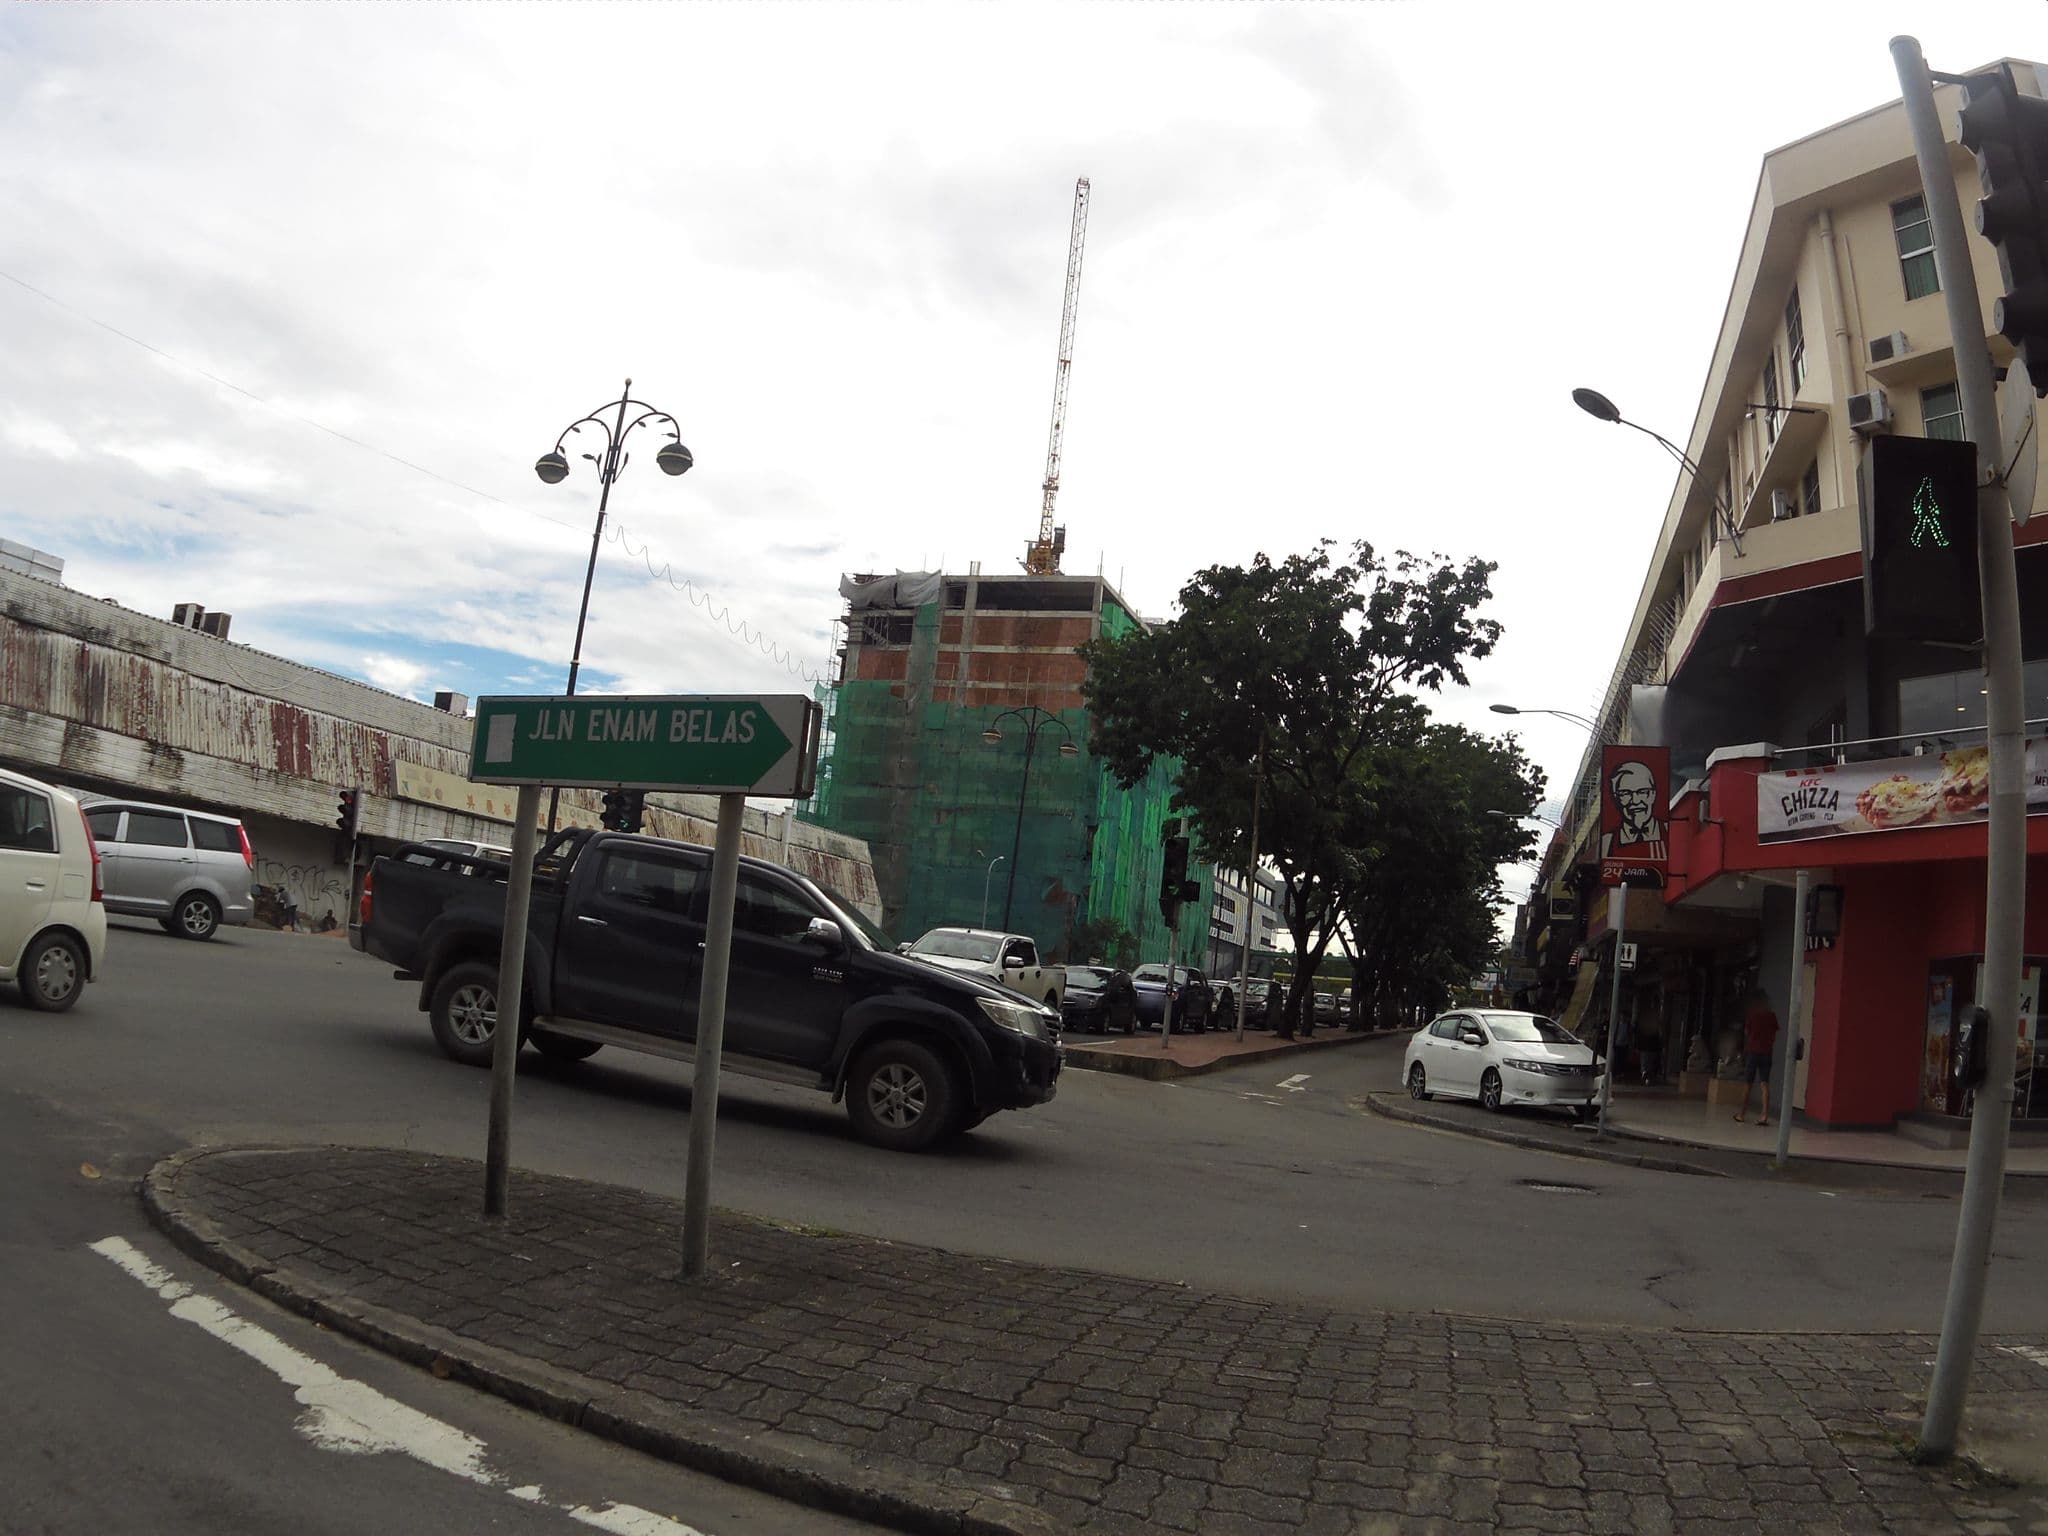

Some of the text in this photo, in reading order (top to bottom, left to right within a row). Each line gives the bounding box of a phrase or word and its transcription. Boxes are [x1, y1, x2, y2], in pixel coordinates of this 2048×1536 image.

[528, 709, 757, 744] JLN ENAM BELAS
[1799, 778, 1822, 788] KFC
[1780, 786, 1840, 817] CHIZZA
[1602, 867, 1622, 878] 24
